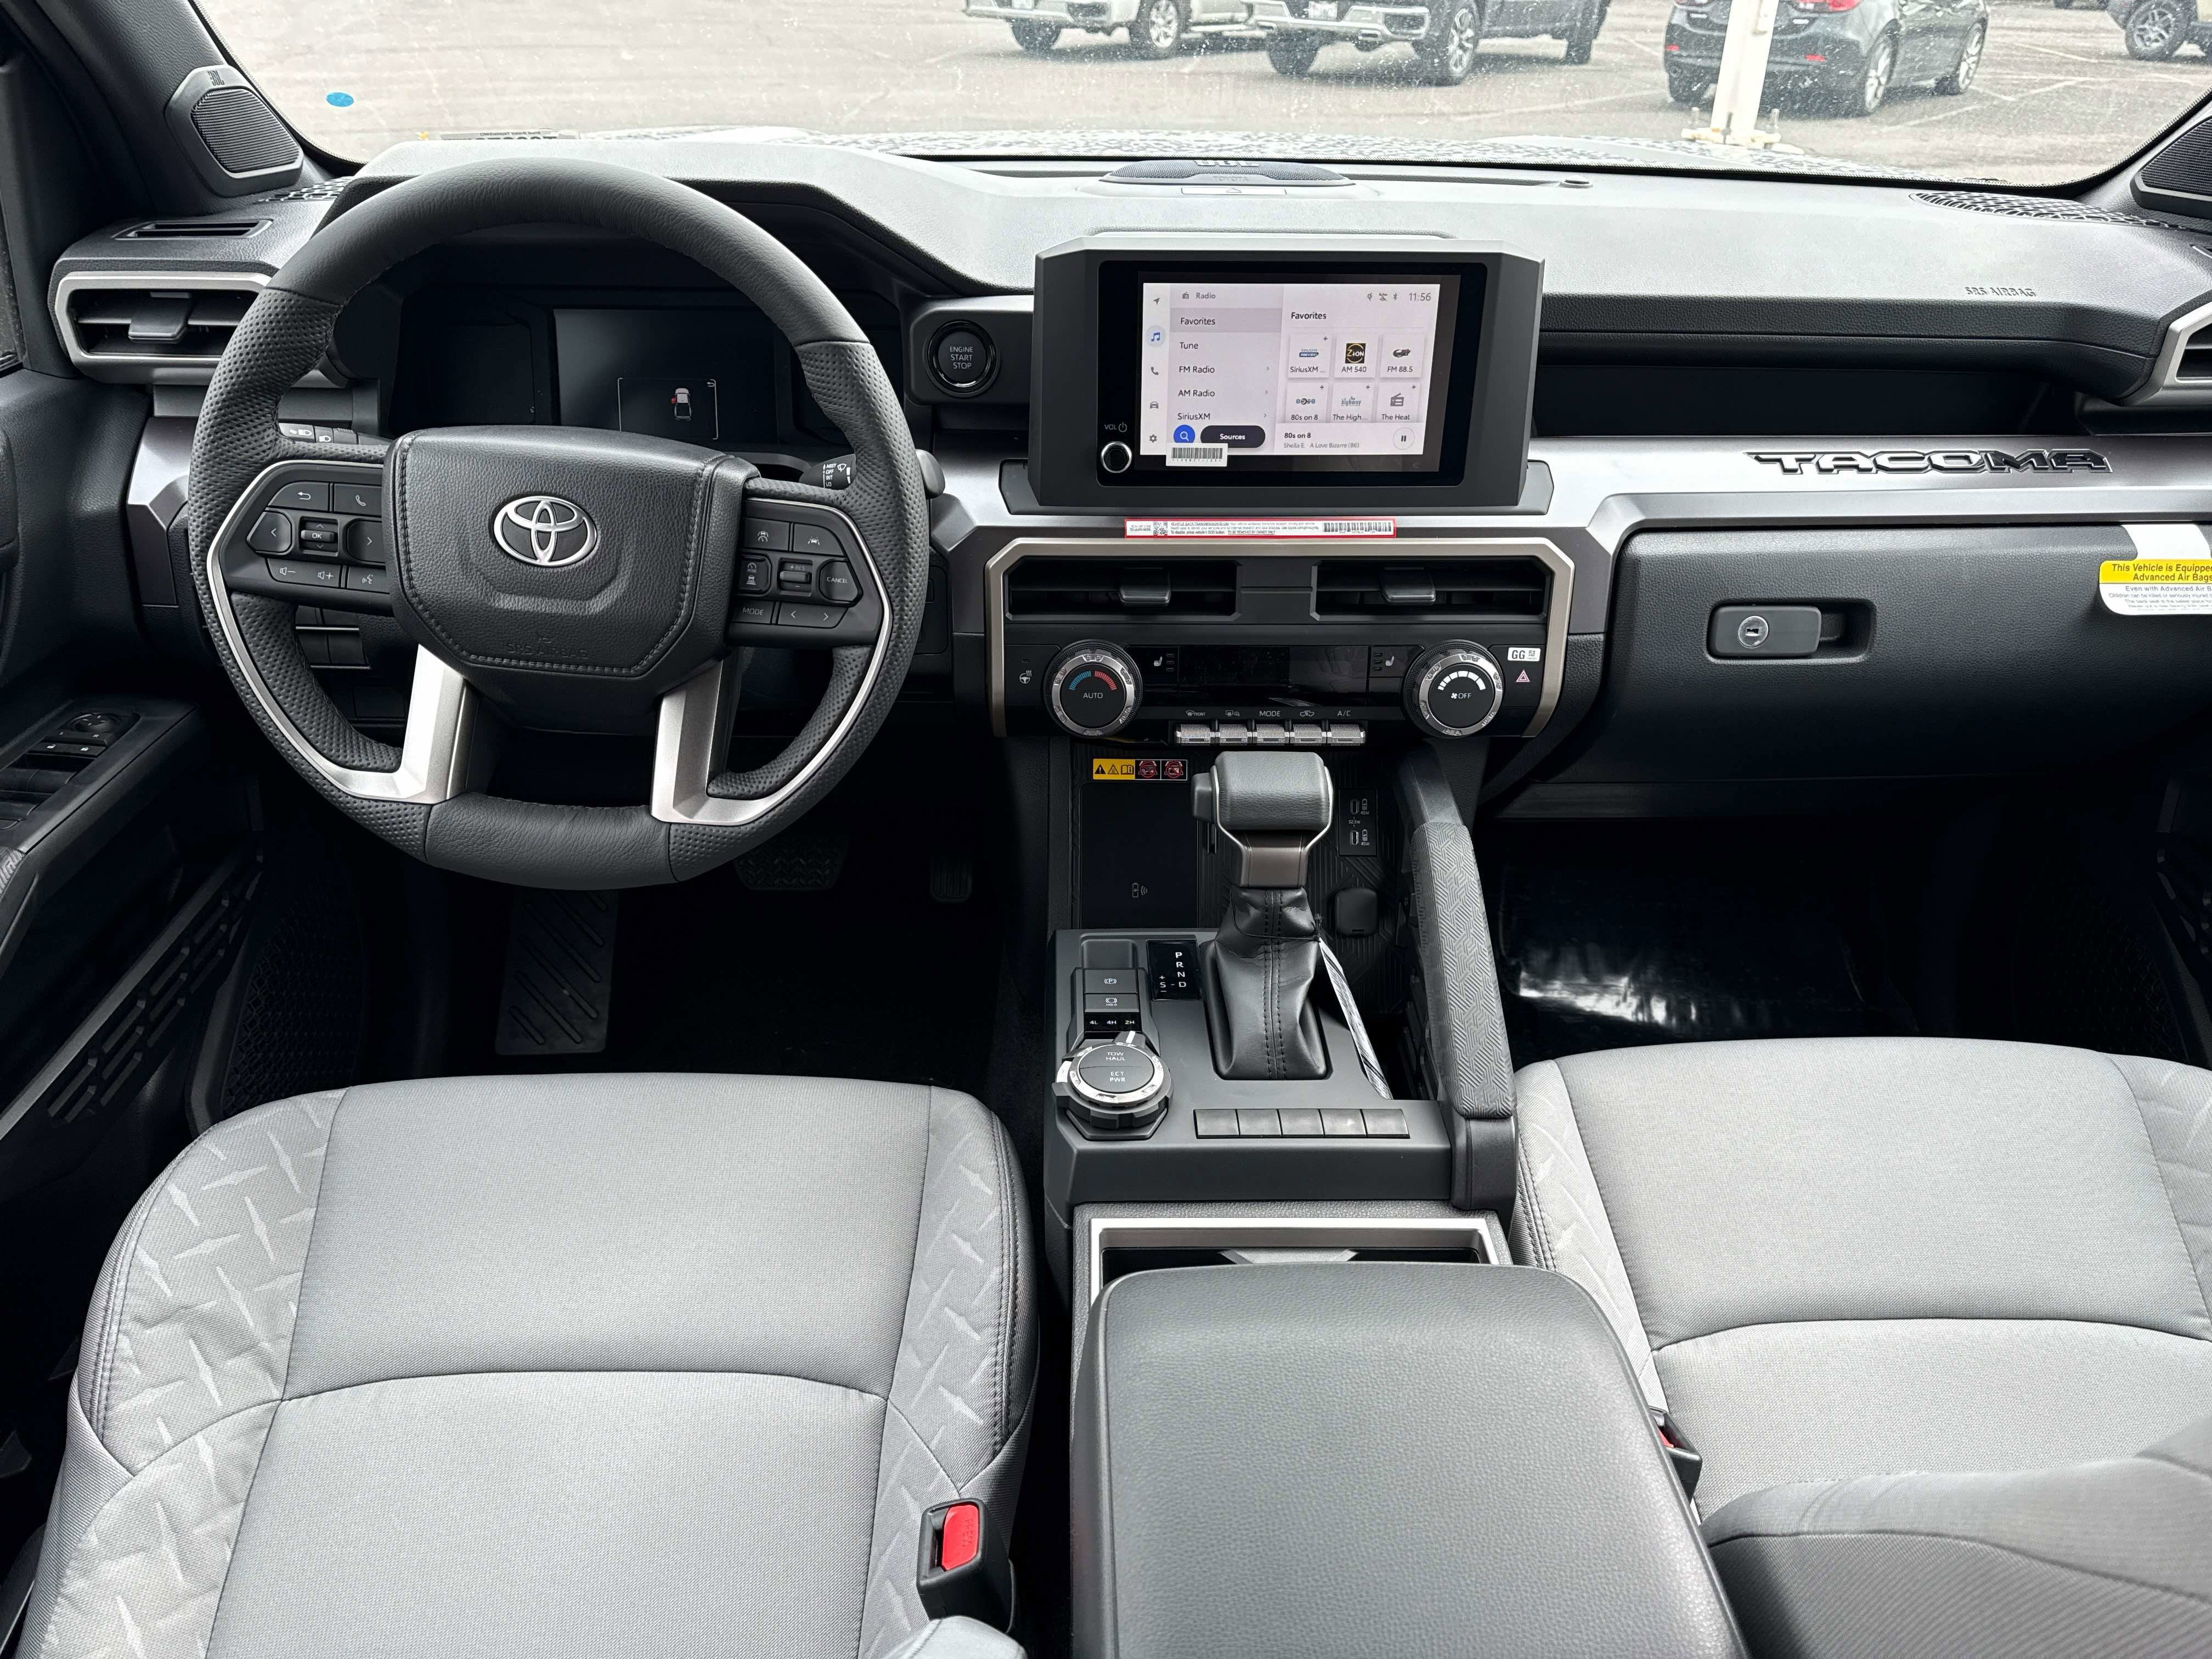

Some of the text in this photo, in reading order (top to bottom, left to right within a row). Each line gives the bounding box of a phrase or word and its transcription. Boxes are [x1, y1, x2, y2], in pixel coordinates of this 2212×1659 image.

[1409, 292, 1431, 301] 11:56
[1965, 287, 2036, 297] SRS AIRBAG
[1291, 312, 1327, 320] Favorites
[1181, 317, 1216, 325] Favorites
[1193, 389, 1215, 397] Radio
[1745, 449, 2113, 475] TACOMA
[2112, 563, 2130, 572] This
[2133, 563, 2163, 572] Vehicle
[2165, 563, 2173, 572] is
[2133, 573, 2175, 581] Advanced
[2177, 573, 2190, 581] Air
[742, 607, 764, 616] MODE
[1511, 650, 1526, 659] GG
